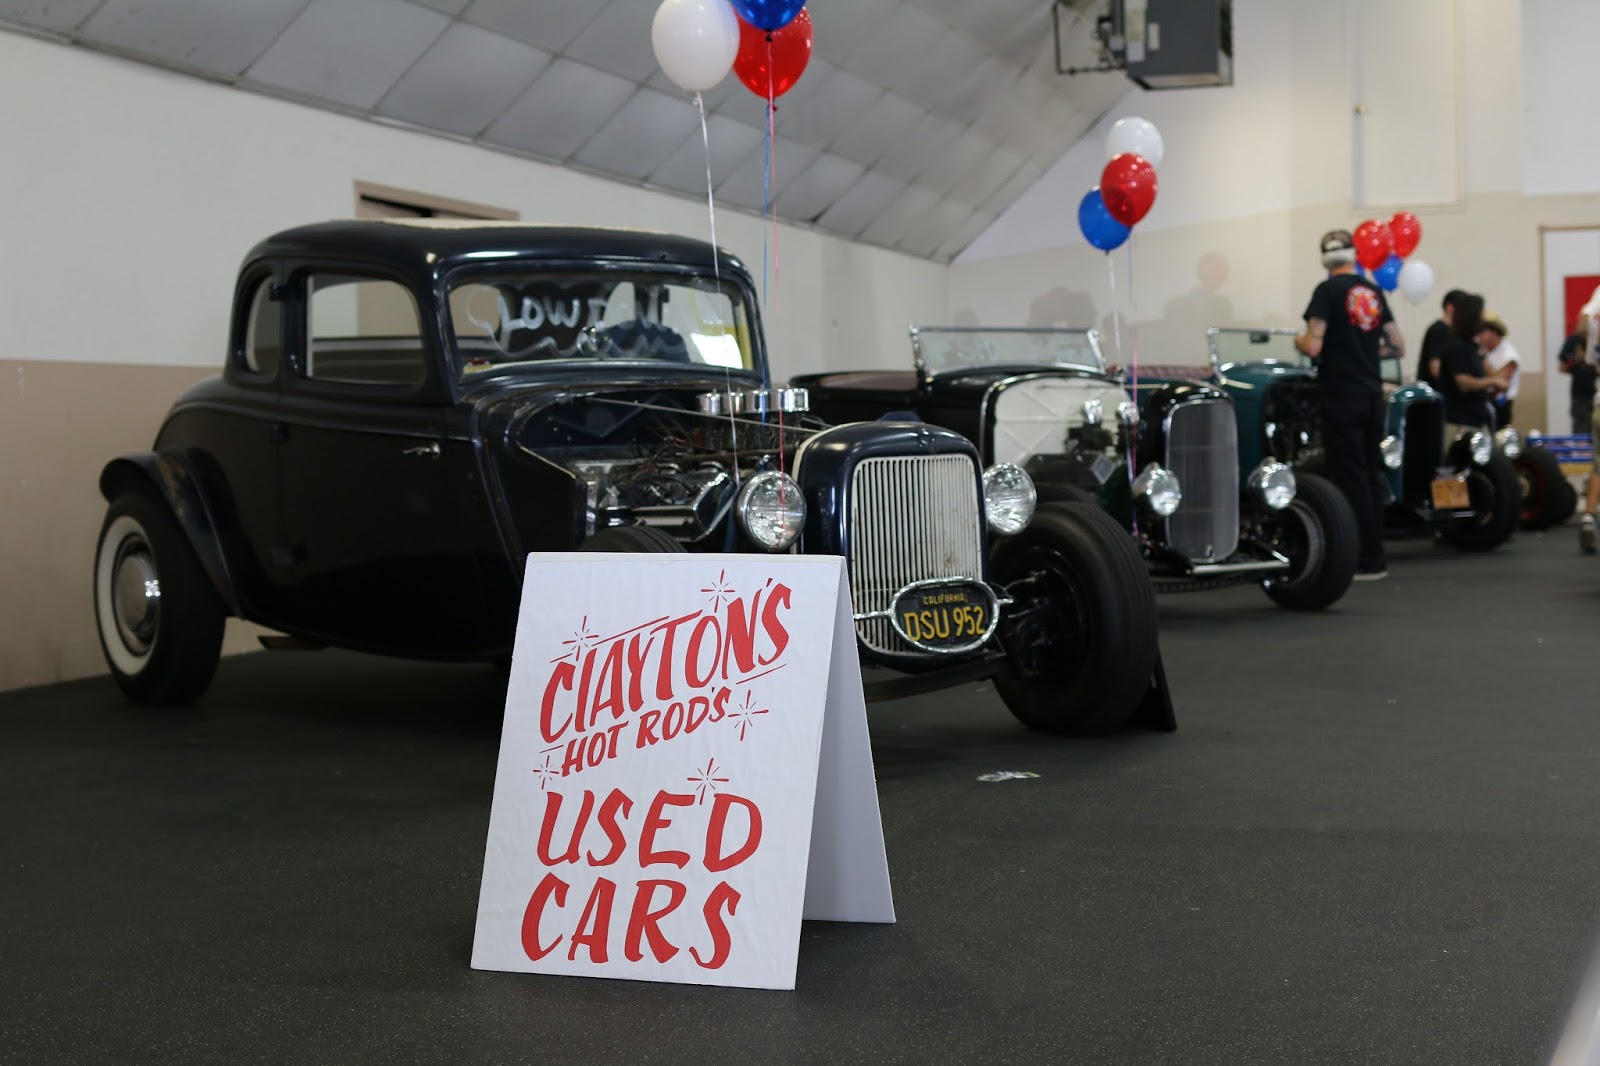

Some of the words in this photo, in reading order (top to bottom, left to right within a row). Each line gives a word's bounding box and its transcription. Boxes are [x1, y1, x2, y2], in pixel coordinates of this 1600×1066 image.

[496, 296, 580, 331] LOW
[904, 608, 950, 641] DSU
[953, 605, 986, 637] 952
[923, 592, 966, 606] CALIFORNIA
[561, 720, 629, 777] HOT
[636, 686, 731, 749] ROD'S
[537, 788, 763, 873] USED
[521, 872, 741, 970] CARS
